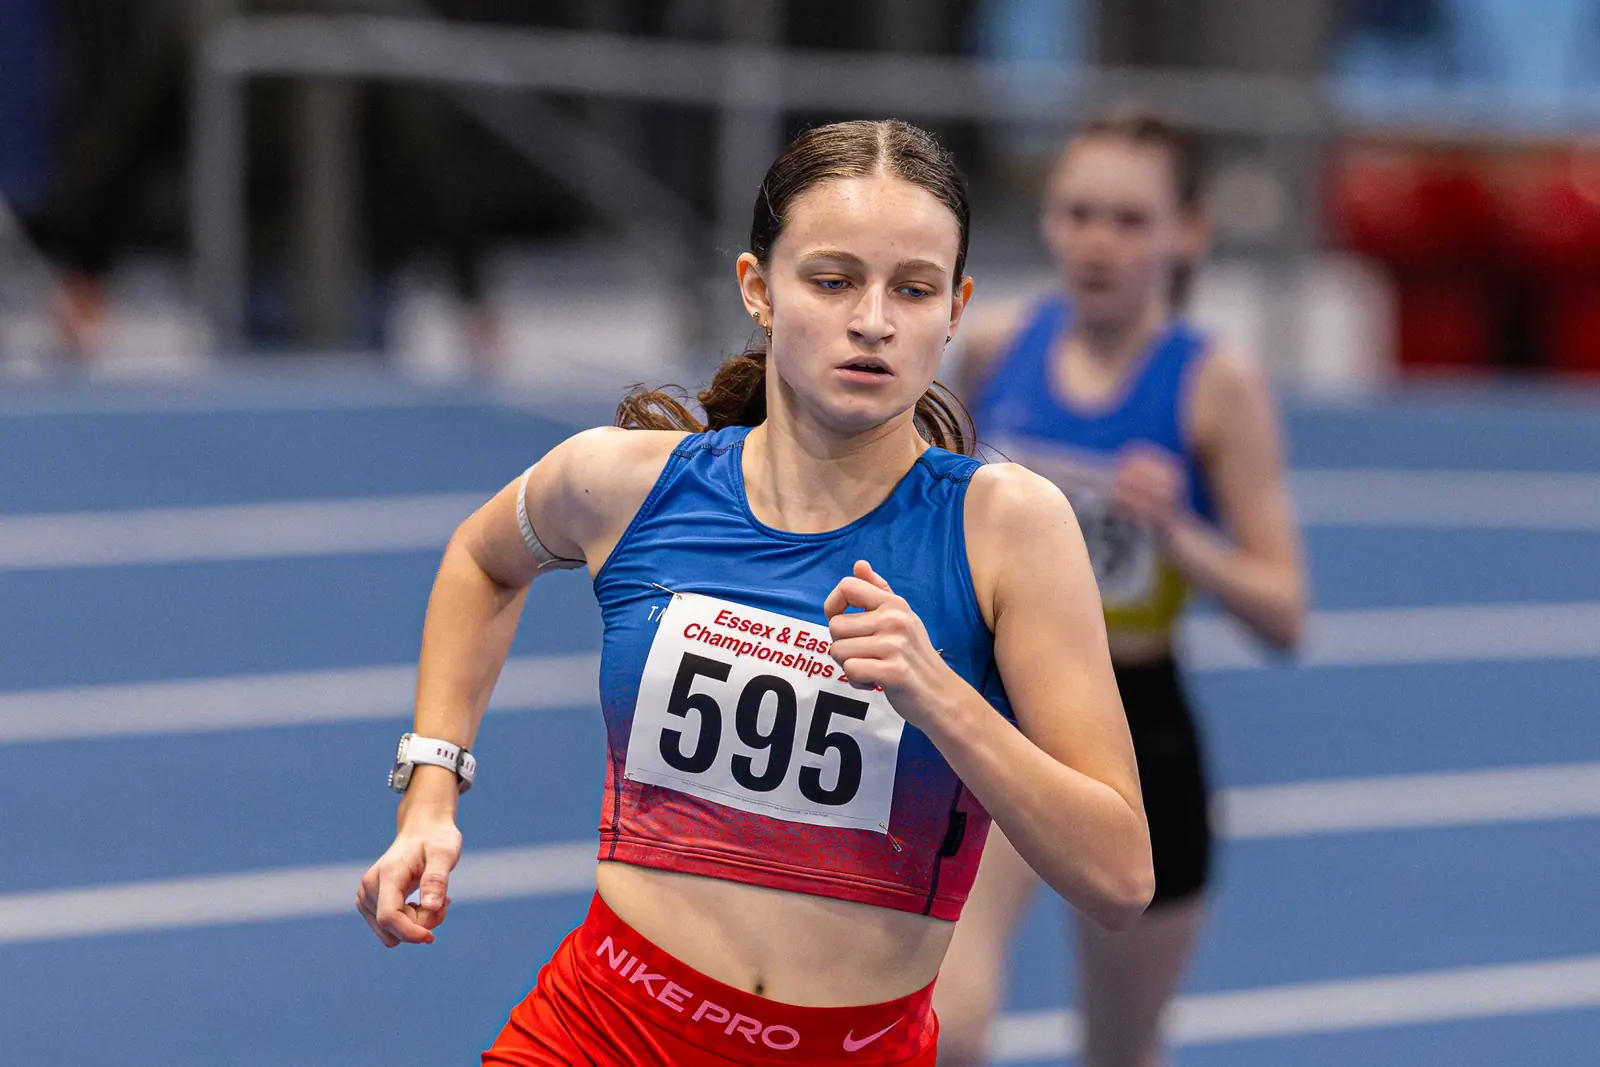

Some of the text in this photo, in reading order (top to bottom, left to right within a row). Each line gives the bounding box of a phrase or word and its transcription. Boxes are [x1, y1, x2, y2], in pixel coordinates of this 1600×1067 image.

[683, 623, 835, 678] Championships
[713, 609, 775, 639] Essex
[776, 627, 791, 644] &
[659, 651, 870, 806] 595
[596, 936, 800, 1050] NIKE PRO
